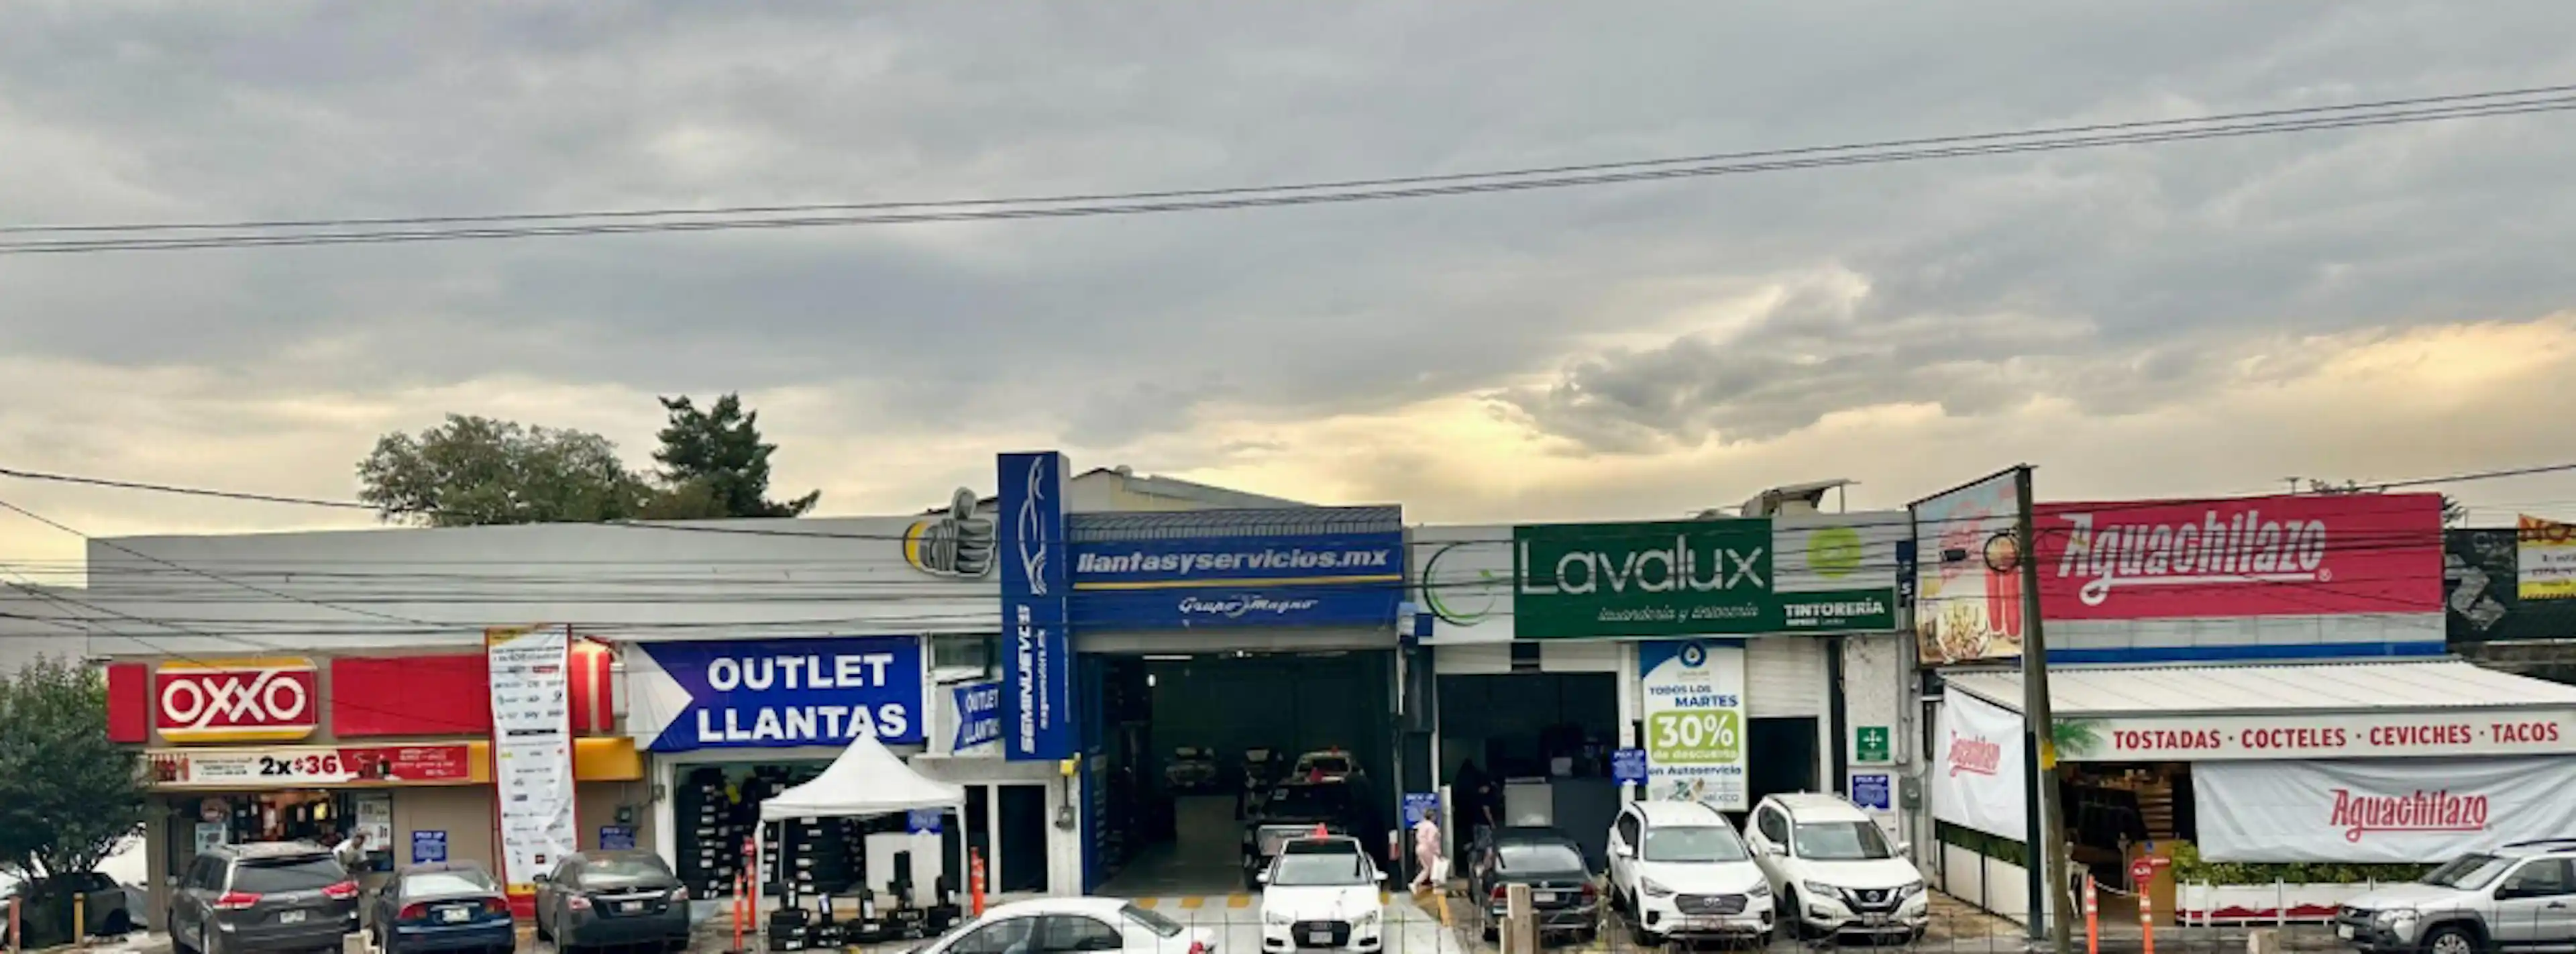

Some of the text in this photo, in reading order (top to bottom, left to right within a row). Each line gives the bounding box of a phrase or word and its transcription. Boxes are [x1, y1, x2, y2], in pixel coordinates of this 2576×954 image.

[1077, 548, 1390, 575] llantasyservicios.mx
[1520, 535, 1765, 594] Lavalux
[2057, 510, 2326, 605] Aguachilazo
[1179, 596, 1240, 615] Grupo
[1678, 608, 1688, 623] y
[1783, 596, 1885, 617] TINTORERÍA
[707, 653, 894, 691] OUTLET
[1017, 604, 1036, 755] SEMINUEVOS
[161, 670, 306, 729] OXXO
[966, 689, 999, 713] OUTLET
[1650, 684, 1711, 696] TODOS LOS
[1675, 694, 1739, 708] MARTES
[697, 704, 908, 743] LLANTAS
[1657, 714, 1735, 748] 30%
[2113, 722, 2560, 750] TOSTADAS COCTELES CEVICHES TACOS
[1668, 764, 1741, 776] Autoservicio
[2329, 788, 2487, 843] Aguachilazo
